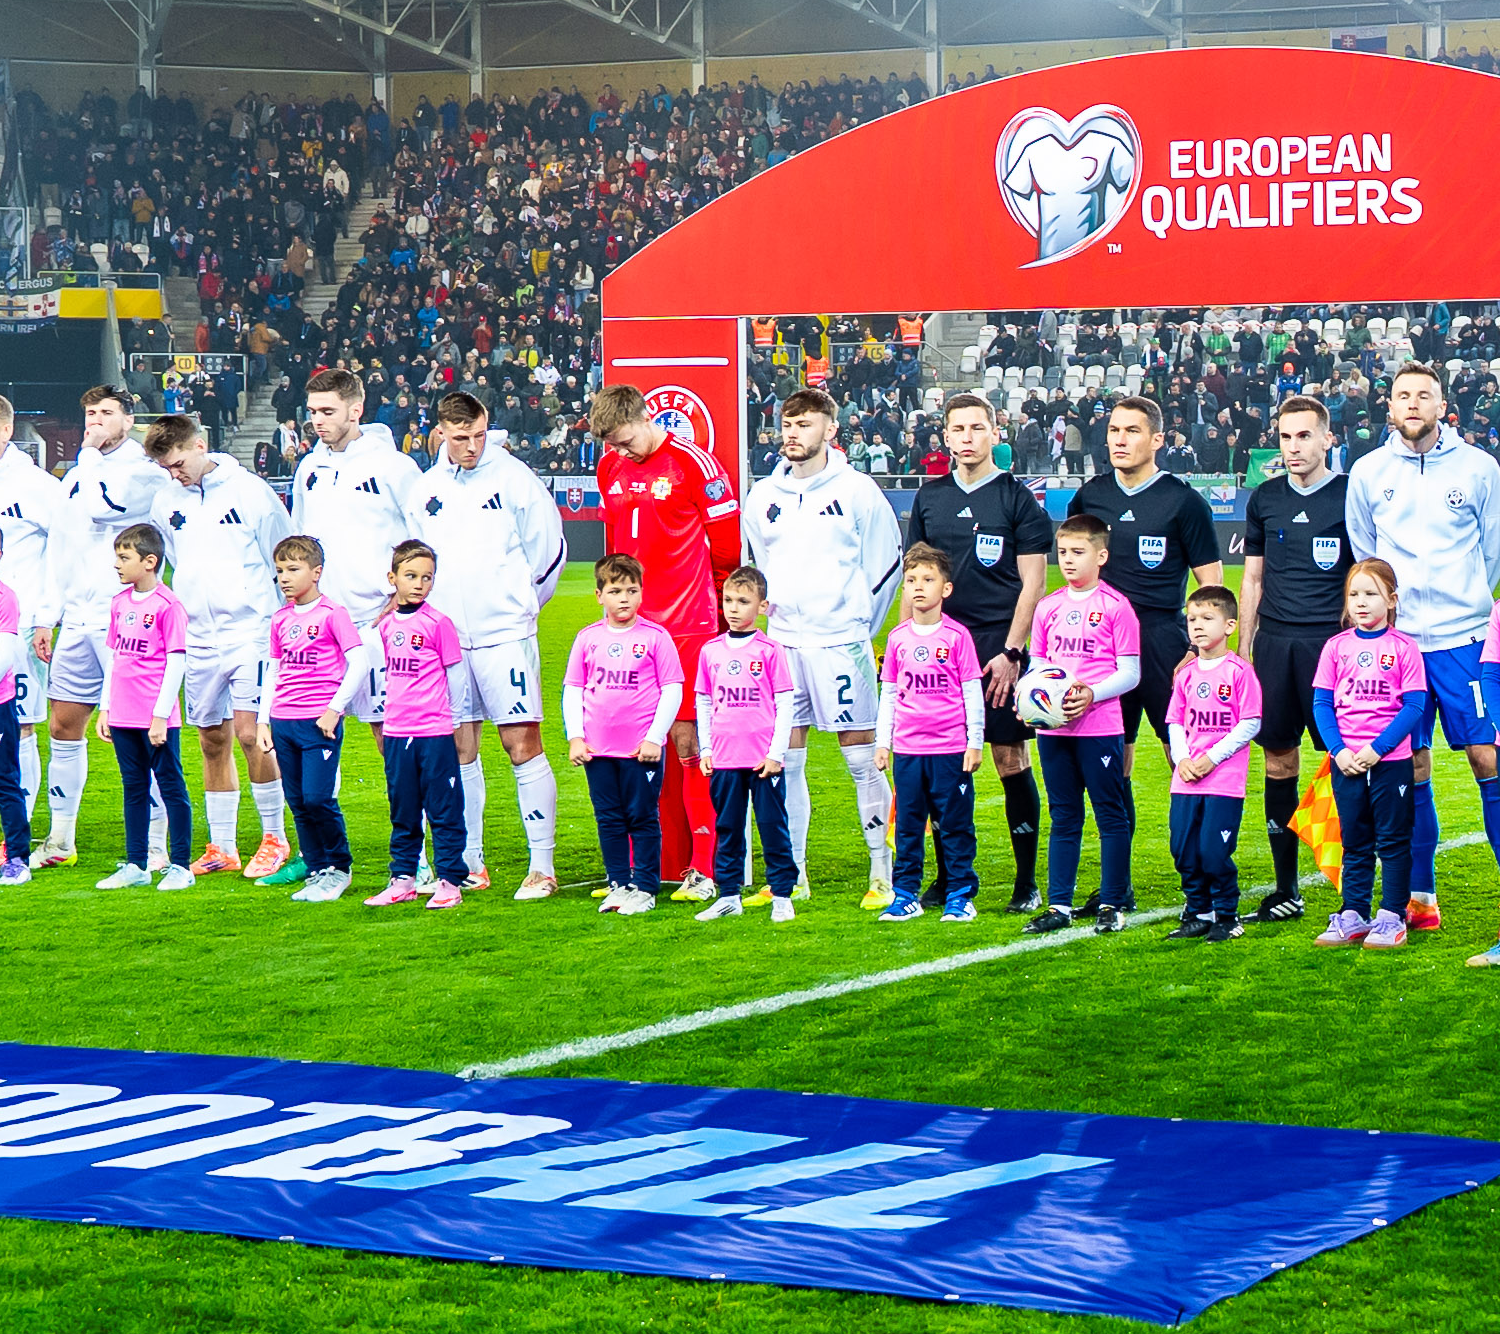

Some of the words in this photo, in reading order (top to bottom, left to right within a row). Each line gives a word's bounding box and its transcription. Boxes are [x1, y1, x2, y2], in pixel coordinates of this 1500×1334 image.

[1170, 132, 1392, 180] EUROPEAN
[1141, 178, 1423, 239] QUALIFIERS
[1107, 243, 1122, 254] TM
[648, 393, 695, 416] UEFA
[631, 507, 639, 539] 1
[979, 536, 1001, 547] FIFA
[1141, 538, 1163, 548] FIFA
[1315, 539, 1337, 549] FIFA
[510, 667, 526, 697] 4
[835, 674, 853, 704] 2
